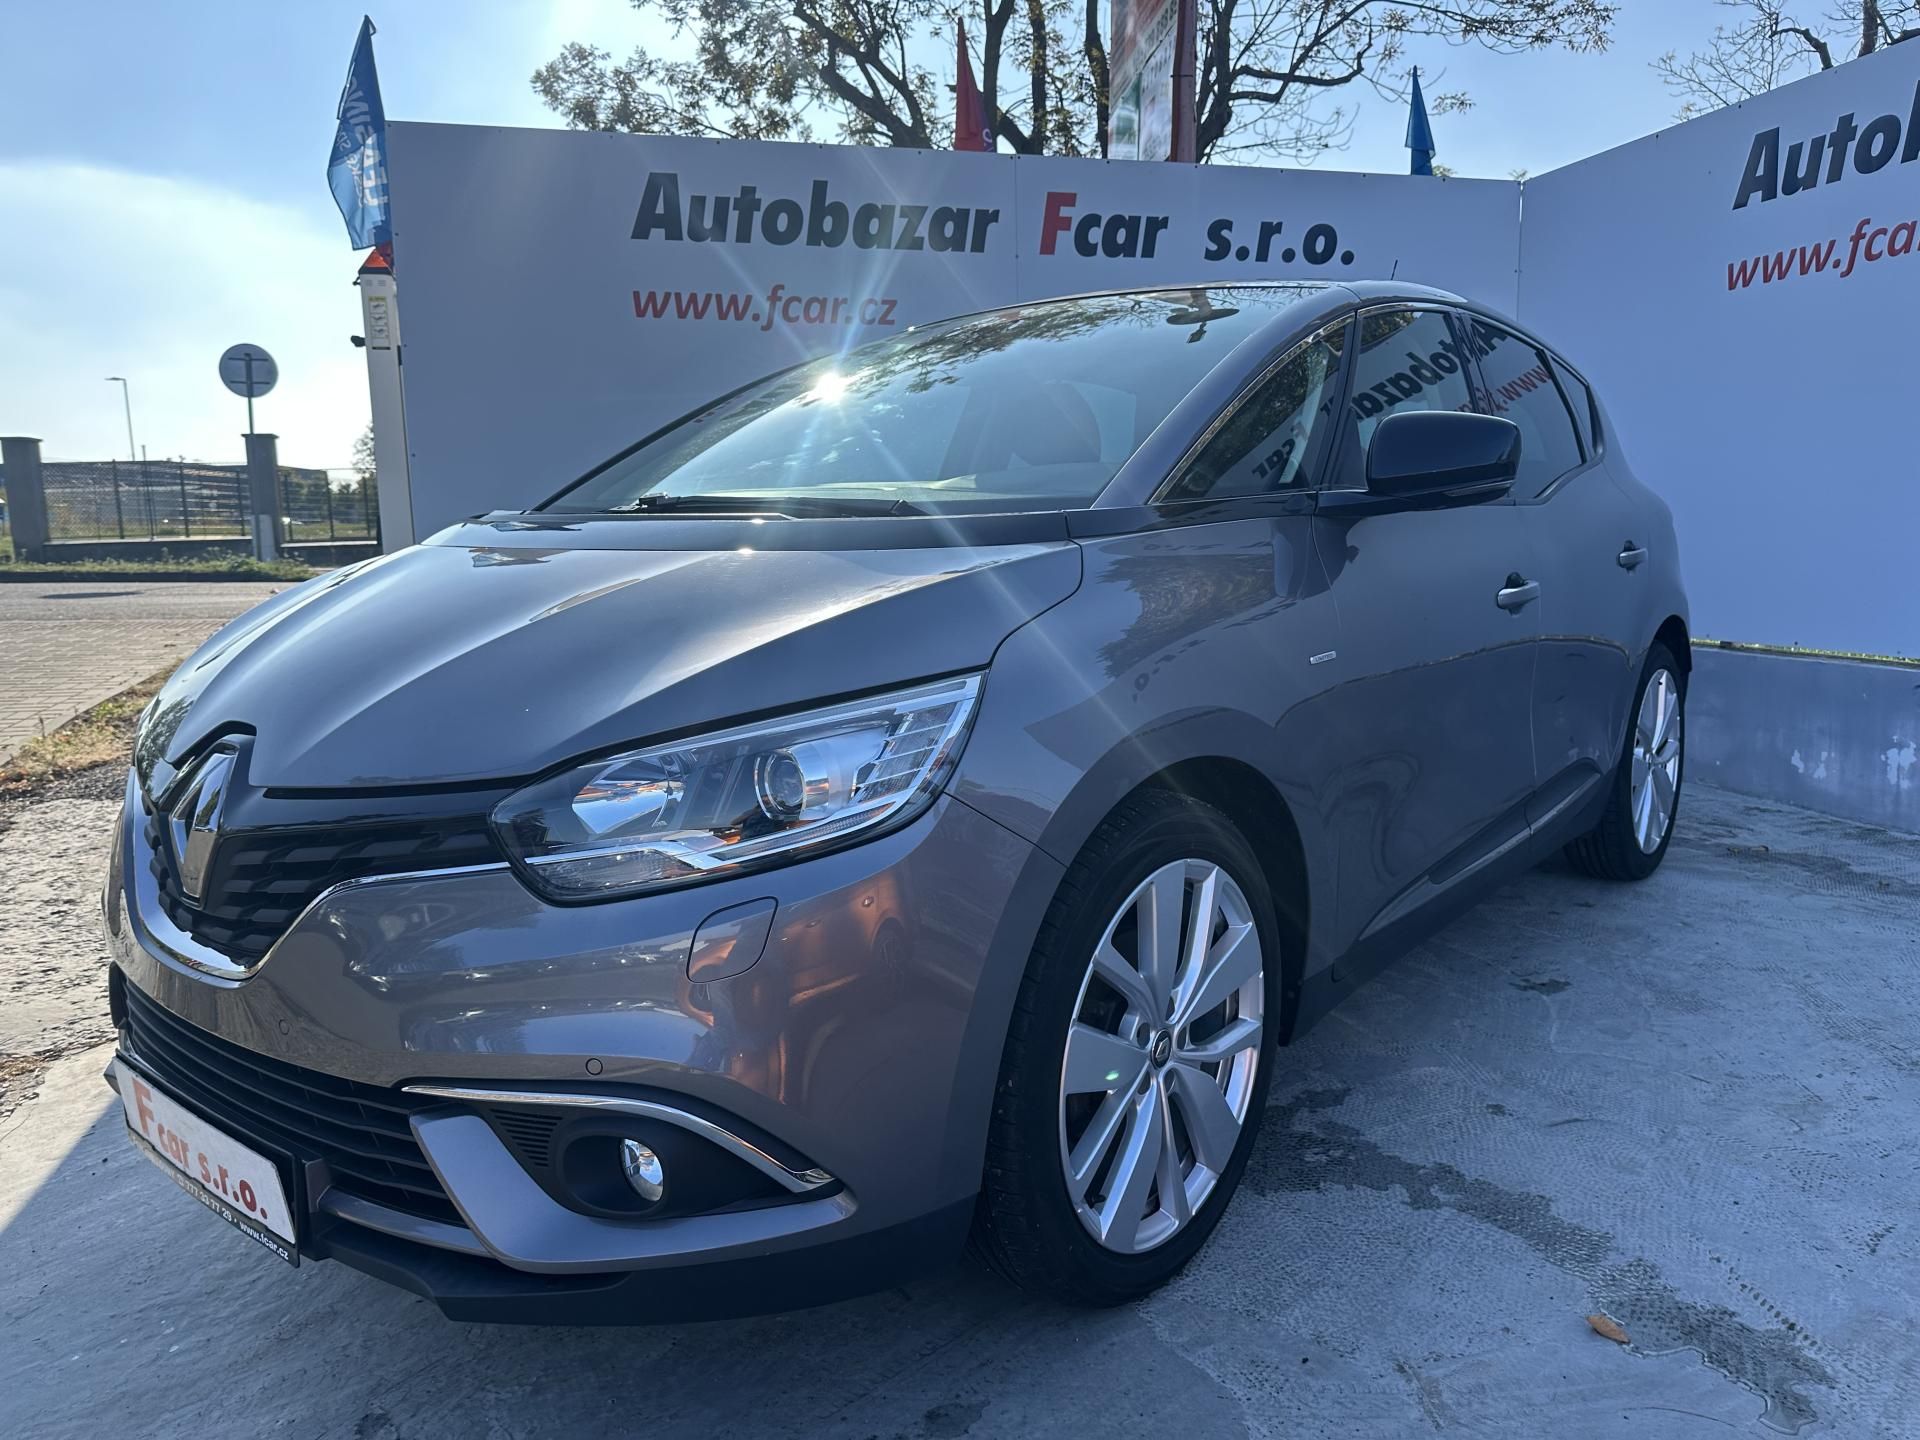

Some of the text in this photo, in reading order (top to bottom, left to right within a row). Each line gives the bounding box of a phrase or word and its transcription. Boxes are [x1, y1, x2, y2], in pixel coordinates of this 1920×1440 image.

[631, 171, 1355, 266] Autobazar Fcar s.r.o.
[1727, 217, 1920, 291] www.fca
[632, 283, 898, 332] www.fcar.cz
[197, 1152, 268, 1220] s.r.o.
[239, 1221, 289, 1261] www.fcar.cz
